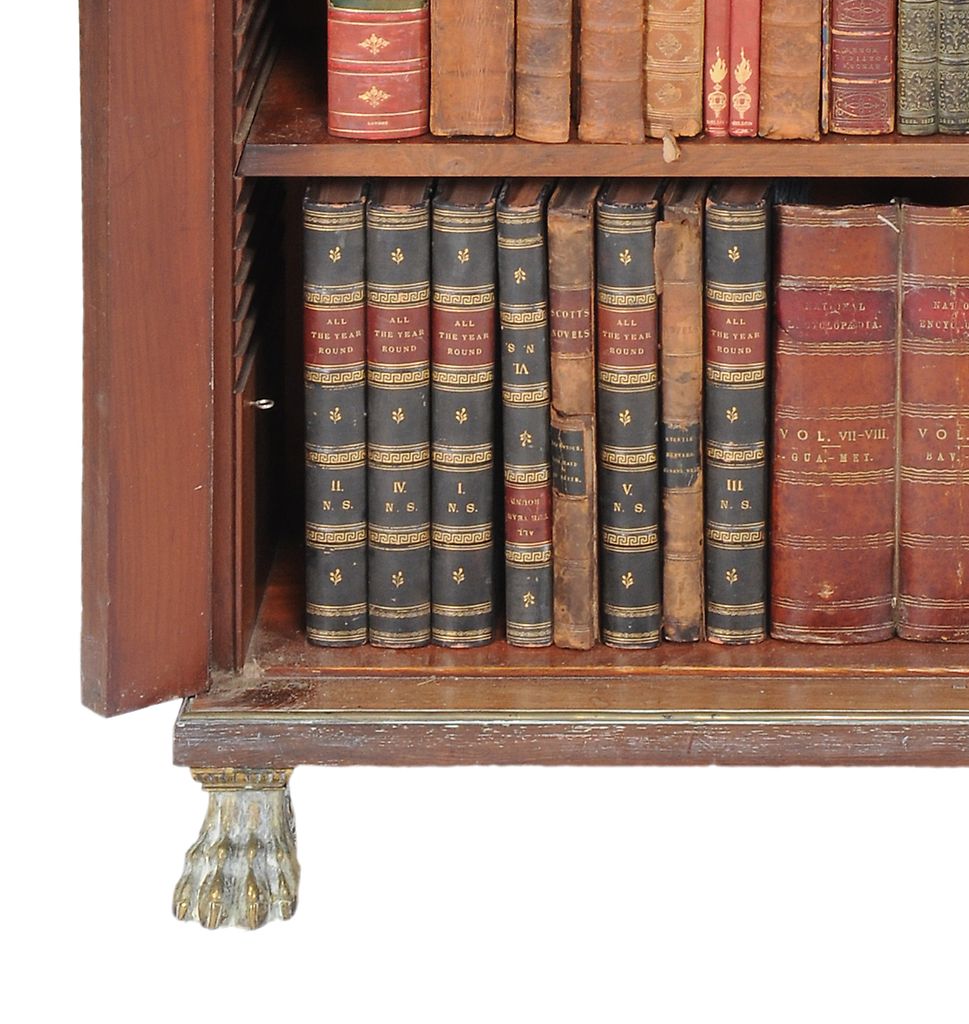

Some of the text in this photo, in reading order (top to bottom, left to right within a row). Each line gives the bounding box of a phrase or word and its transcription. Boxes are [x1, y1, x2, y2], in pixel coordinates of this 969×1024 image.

[311, 330, 361, 339] THE YEAR
[374, 329, 425, 338] THE YEAR
[439, 332, 489, 340] THE YEAR
[603, 331, 651, 341] THE YEAR
[711, 330, 760, 340] THE YEAR
[318, 346, 354, 354] ROUND
[382, 345, 417, 353] ROUND
[447, 347, 482, 356] ROUND
[609, 347, 644, 355] ROUND
[717, 346, 752, 354] ROUND
[780, 428, 831, 442] VOL.
[919, 429, 969, 440] VOL.
[331, 480, 344, 492] II.
[393, 481, 407, 493] IV.
[457, 482, 465, 494] I.
[622, 484, 633, 496] V.
[323, 500, 354, 511] N. S.
[406, 503, 418, 512] S.
[447, 503, 478, 513] N. S.
[613, 502, 646, 513] N. S.
[720, 500, 752, 510] N. S.
